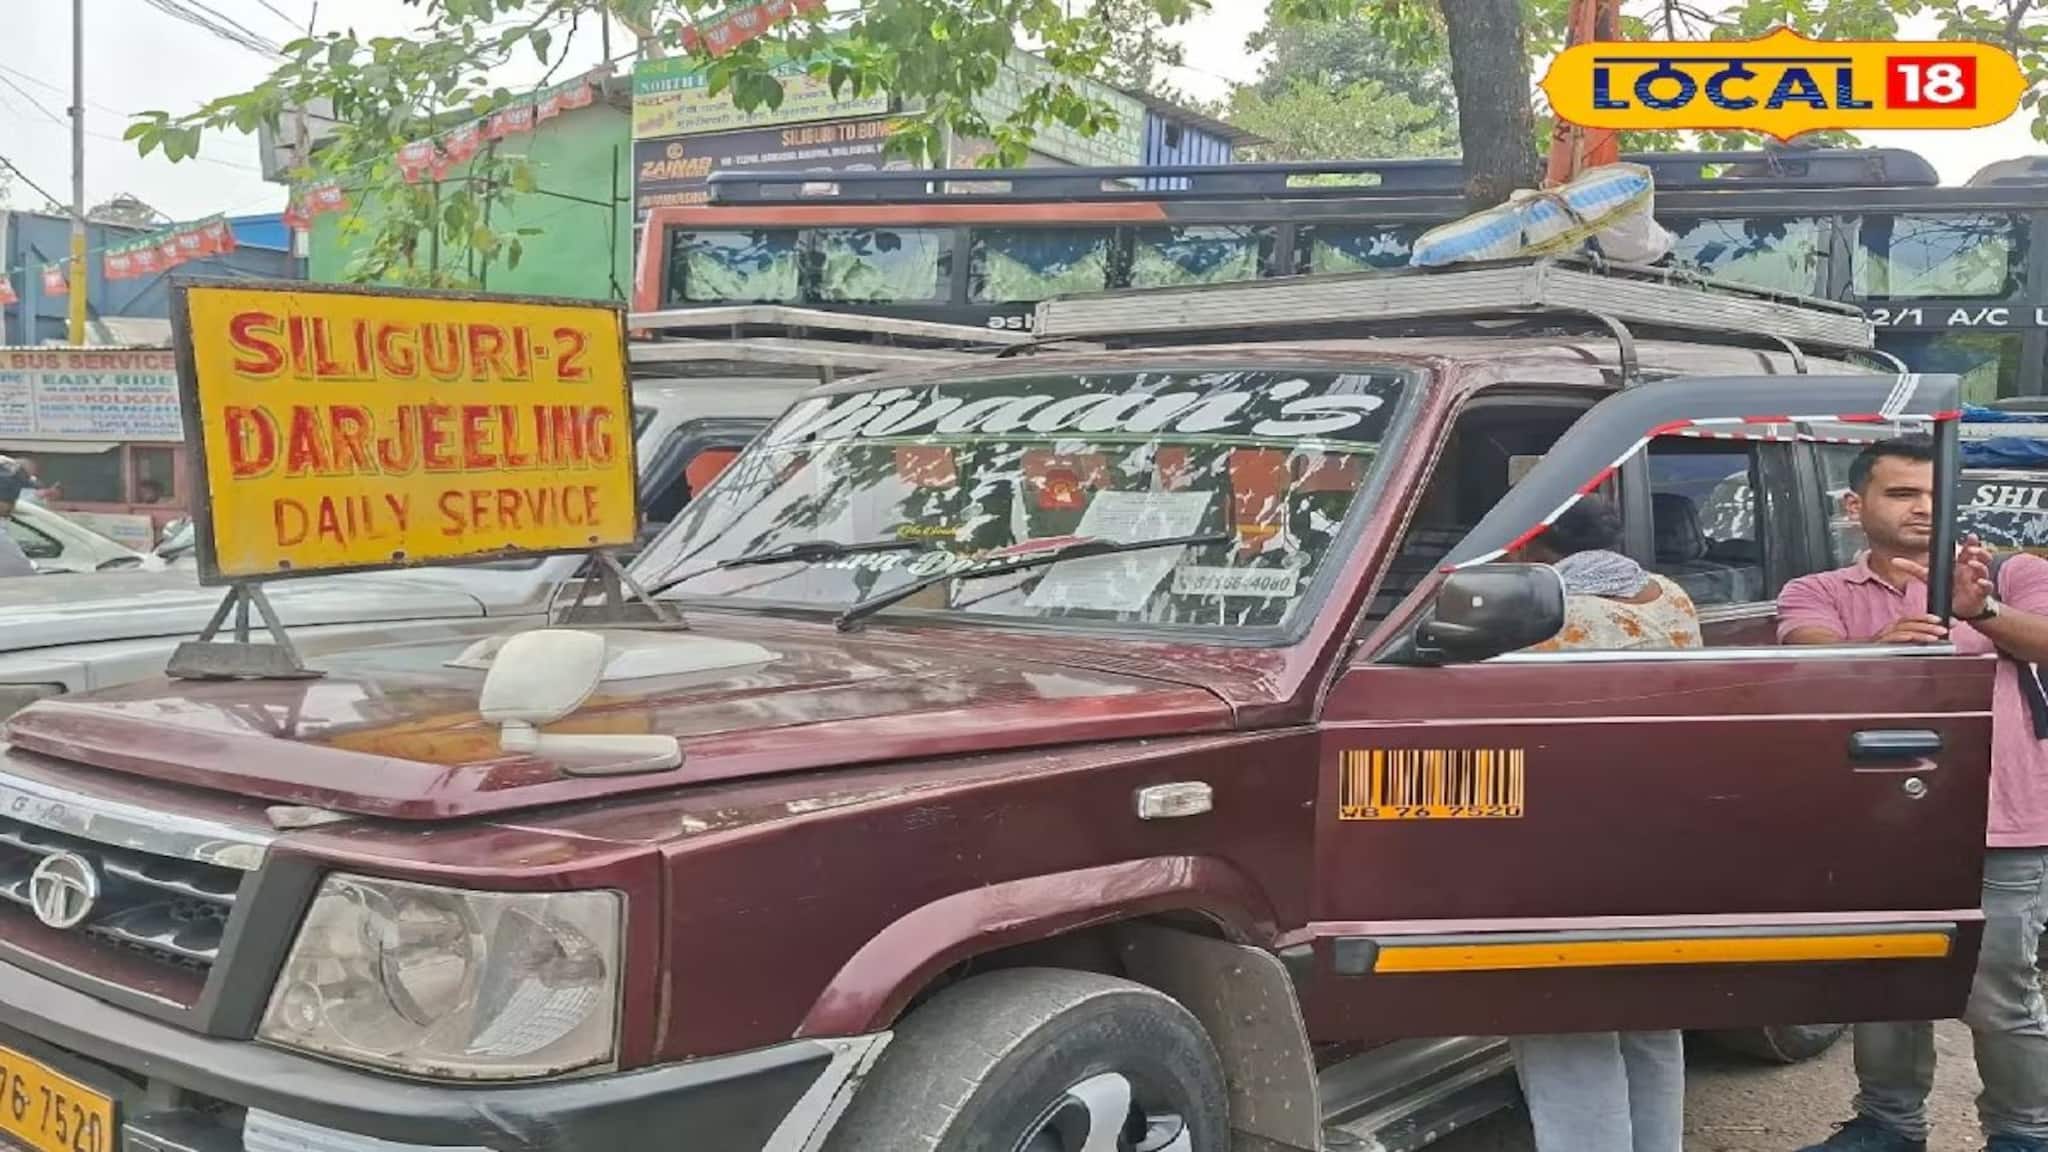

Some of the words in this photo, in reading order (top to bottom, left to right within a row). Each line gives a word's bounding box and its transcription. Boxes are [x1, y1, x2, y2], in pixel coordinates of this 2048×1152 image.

[838, 123, 856, 141] TO
[640, 157, 712, 178] ZAINAB
[1872, 308, 1923, 326] 2/1
[1948, 308, 2009, 326] A/C
[229, 311, 592, 380] SILIGURI-2
[11, 354, 61, 370] BUS
[69, 353, 176, 371] SERVICE
[42, 374, 105, 385] EASY
[224, 402, 615, 479] DARJEELING
[274, 492, 410, 547] DAILY
[439, 485, 601, 538] SERVICE
[1340, 806, 1380, 818] WB
[1394, 806, 1431, 817] 76
[1449, 806, 1521, 817] 7520
